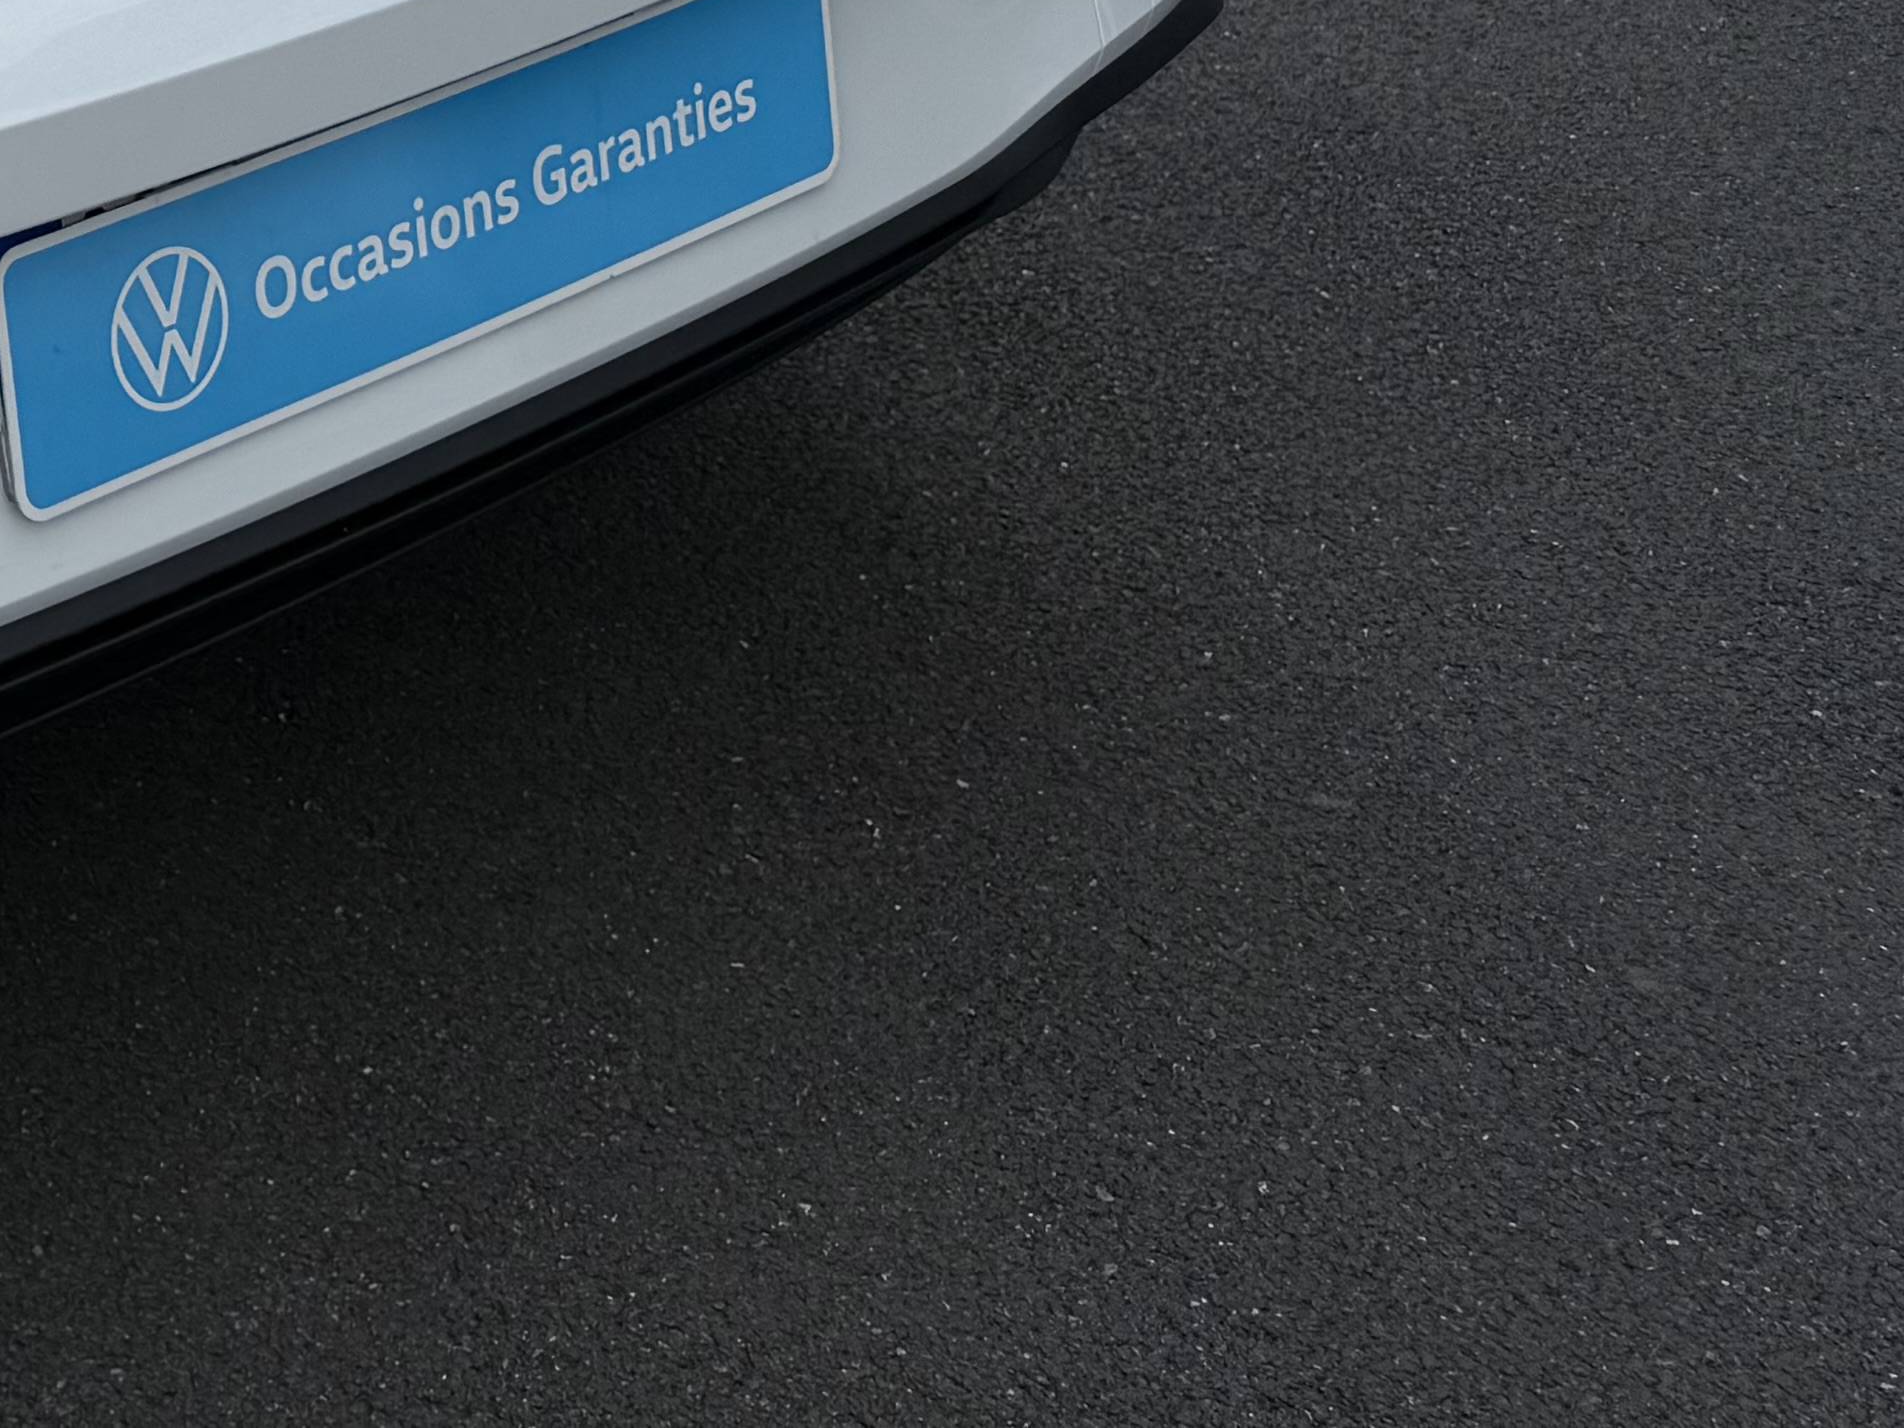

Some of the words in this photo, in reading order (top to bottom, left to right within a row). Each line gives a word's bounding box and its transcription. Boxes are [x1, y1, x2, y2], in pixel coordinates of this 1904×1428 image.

[111, 246, 228, 412] VW
[254, 178, 520, 319] Occasions
[532, 78, 757, 206] Garanties
